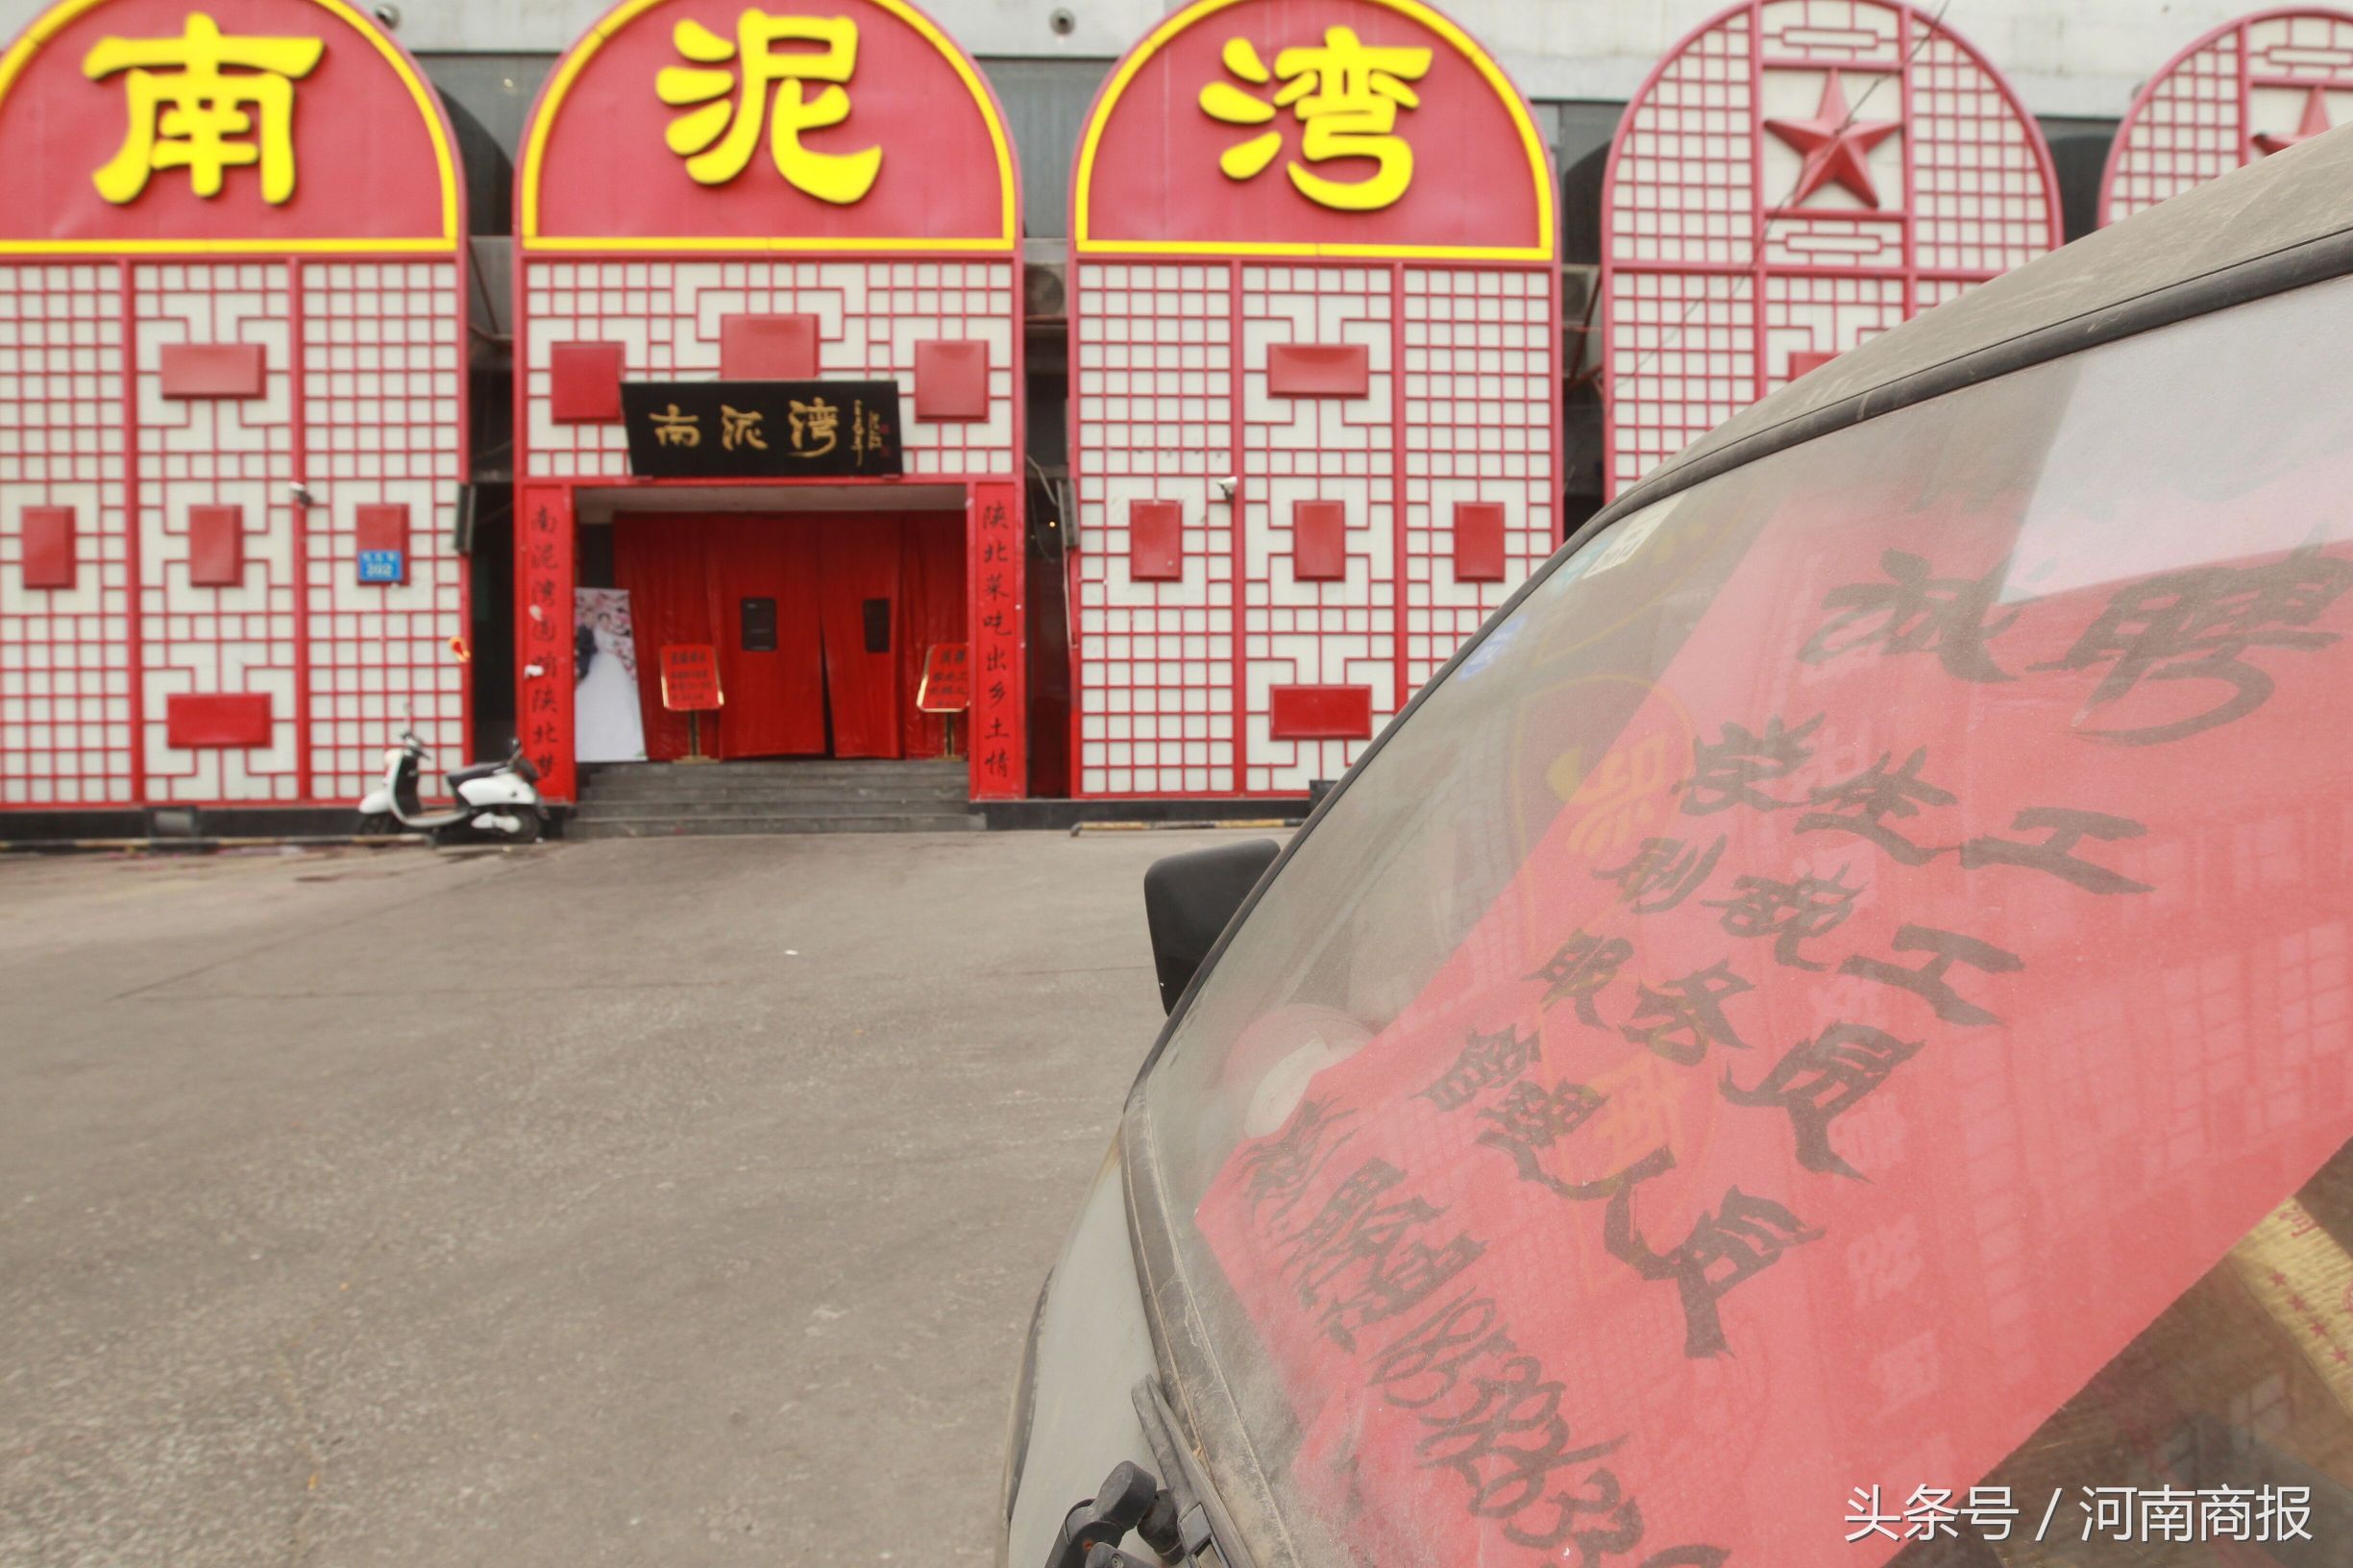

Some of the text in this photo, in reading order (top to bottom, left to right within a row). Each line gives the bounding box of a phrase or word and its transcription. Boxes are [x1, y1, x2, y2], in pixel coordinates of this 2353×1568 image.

[83, 9, 1432, 212] 南 泥 湾
[649, 396, 839, 458] 南泥湾
[982, 502, 1013, 780] 陕北菜吃出乡土情
[1592, 834, 2025, 1027] 刷碗工
[1521, 928, 1925, 1185] 服务员
[1415, 1022, 1826, 1360] 管理人员
